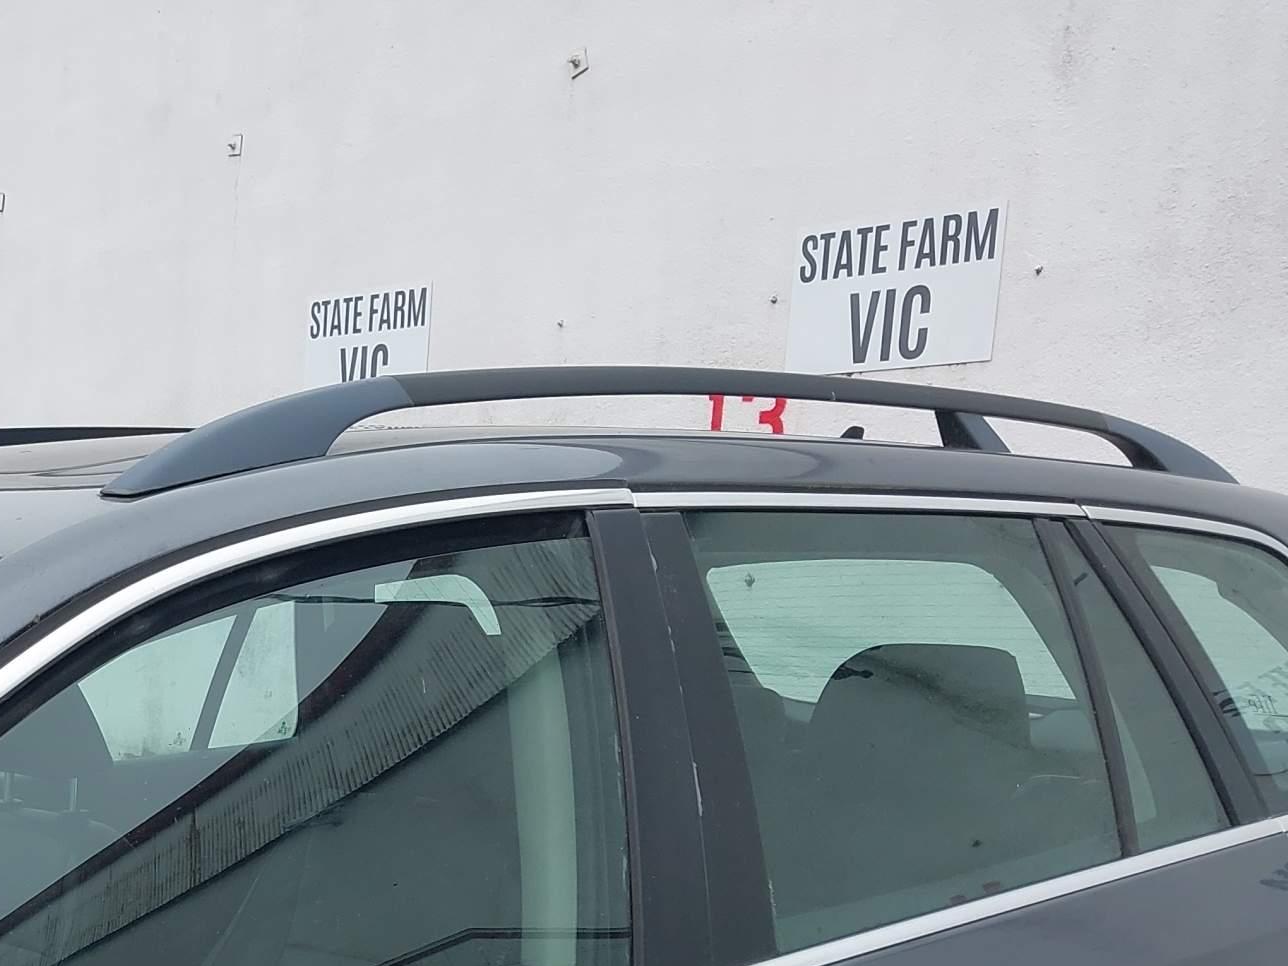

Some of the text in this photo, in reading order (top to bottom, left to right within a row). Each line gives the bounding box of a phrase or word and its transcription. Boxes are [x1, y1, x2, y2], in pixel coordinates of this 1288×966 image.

[799, 208, 999, 283] STATE FARM
[310, 287, 427, 339] STATE FARM
[850, 284, 931, 365] VIC
[340, 343, 389, 383] VIC
